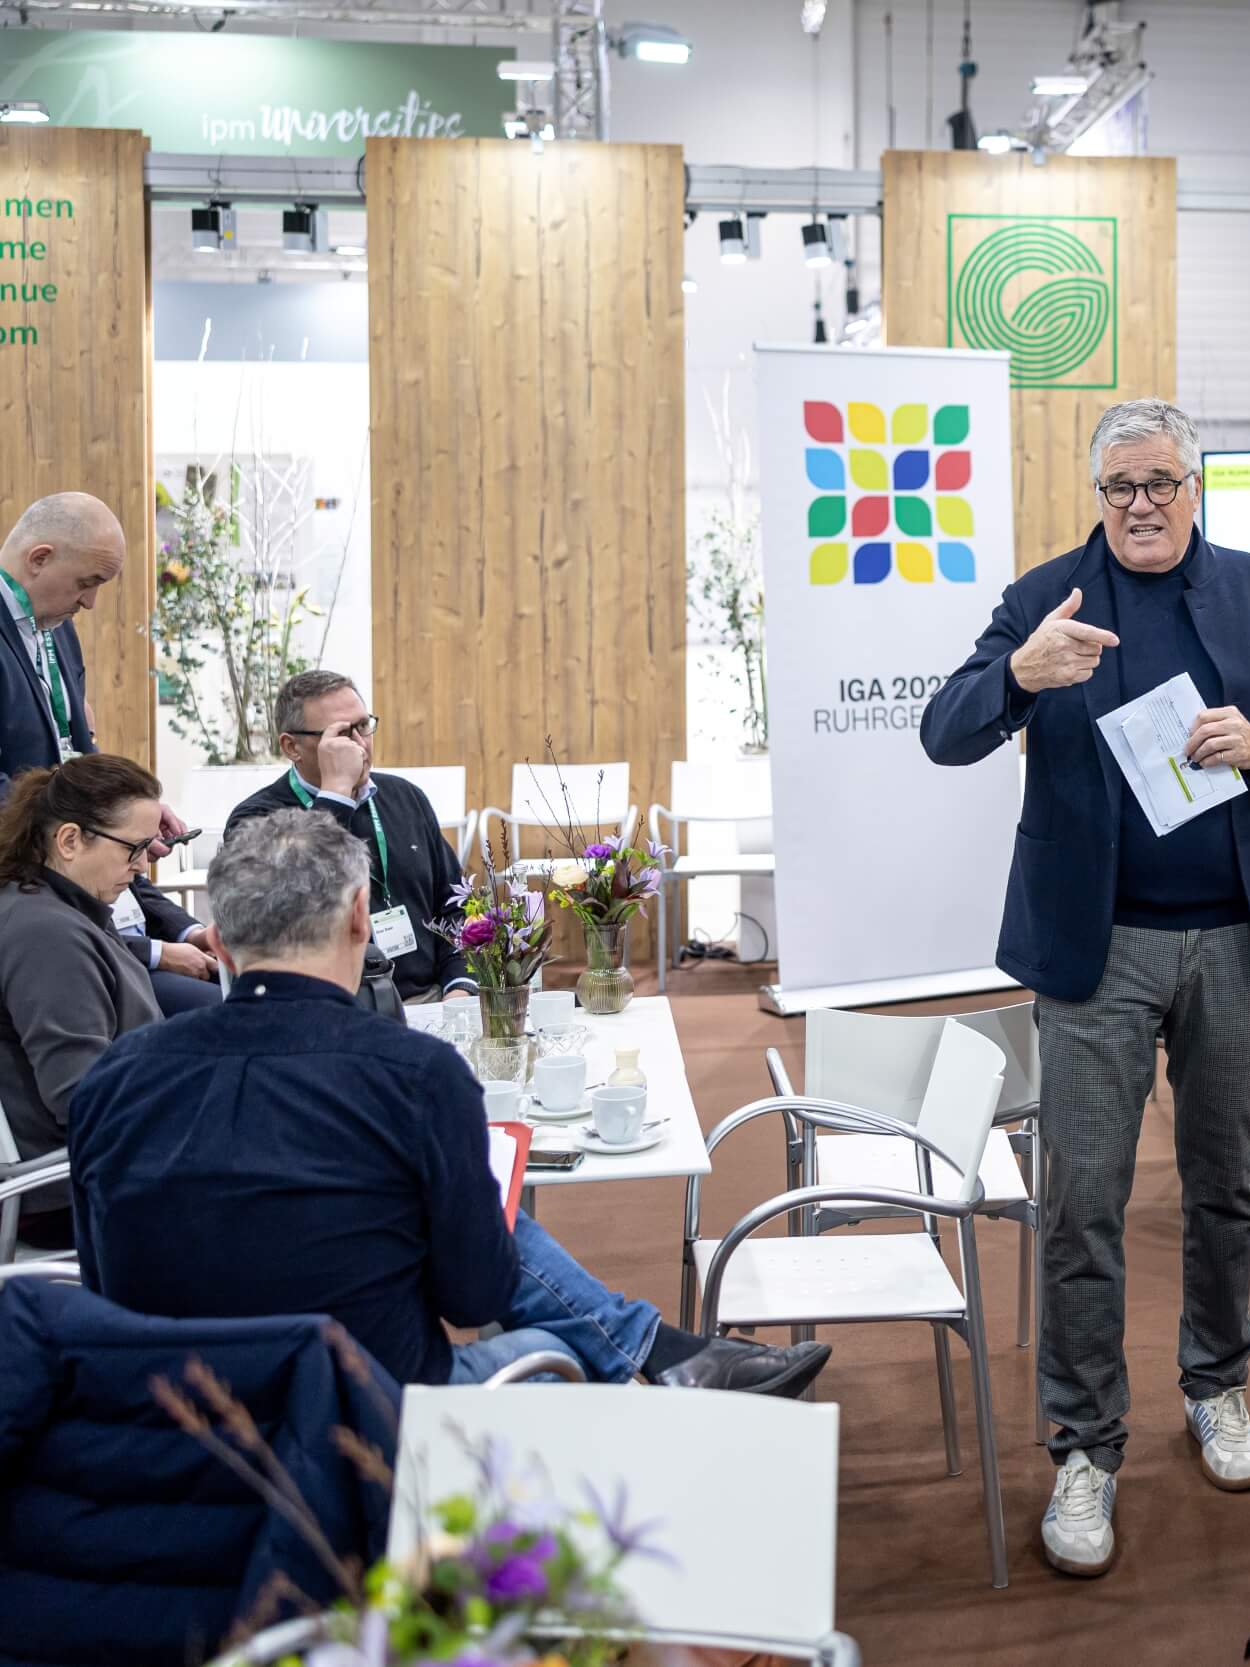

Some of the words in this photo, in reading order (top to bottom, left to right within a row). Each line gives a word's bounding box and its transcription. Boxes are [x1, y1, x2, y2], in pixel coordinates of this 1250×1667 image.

[201, 112, 255, 147] ipm
[0, 197, 73, 219] men
[839, 678, 885, 703] IGA
[814, 704, 923, 733] RUHRGE
